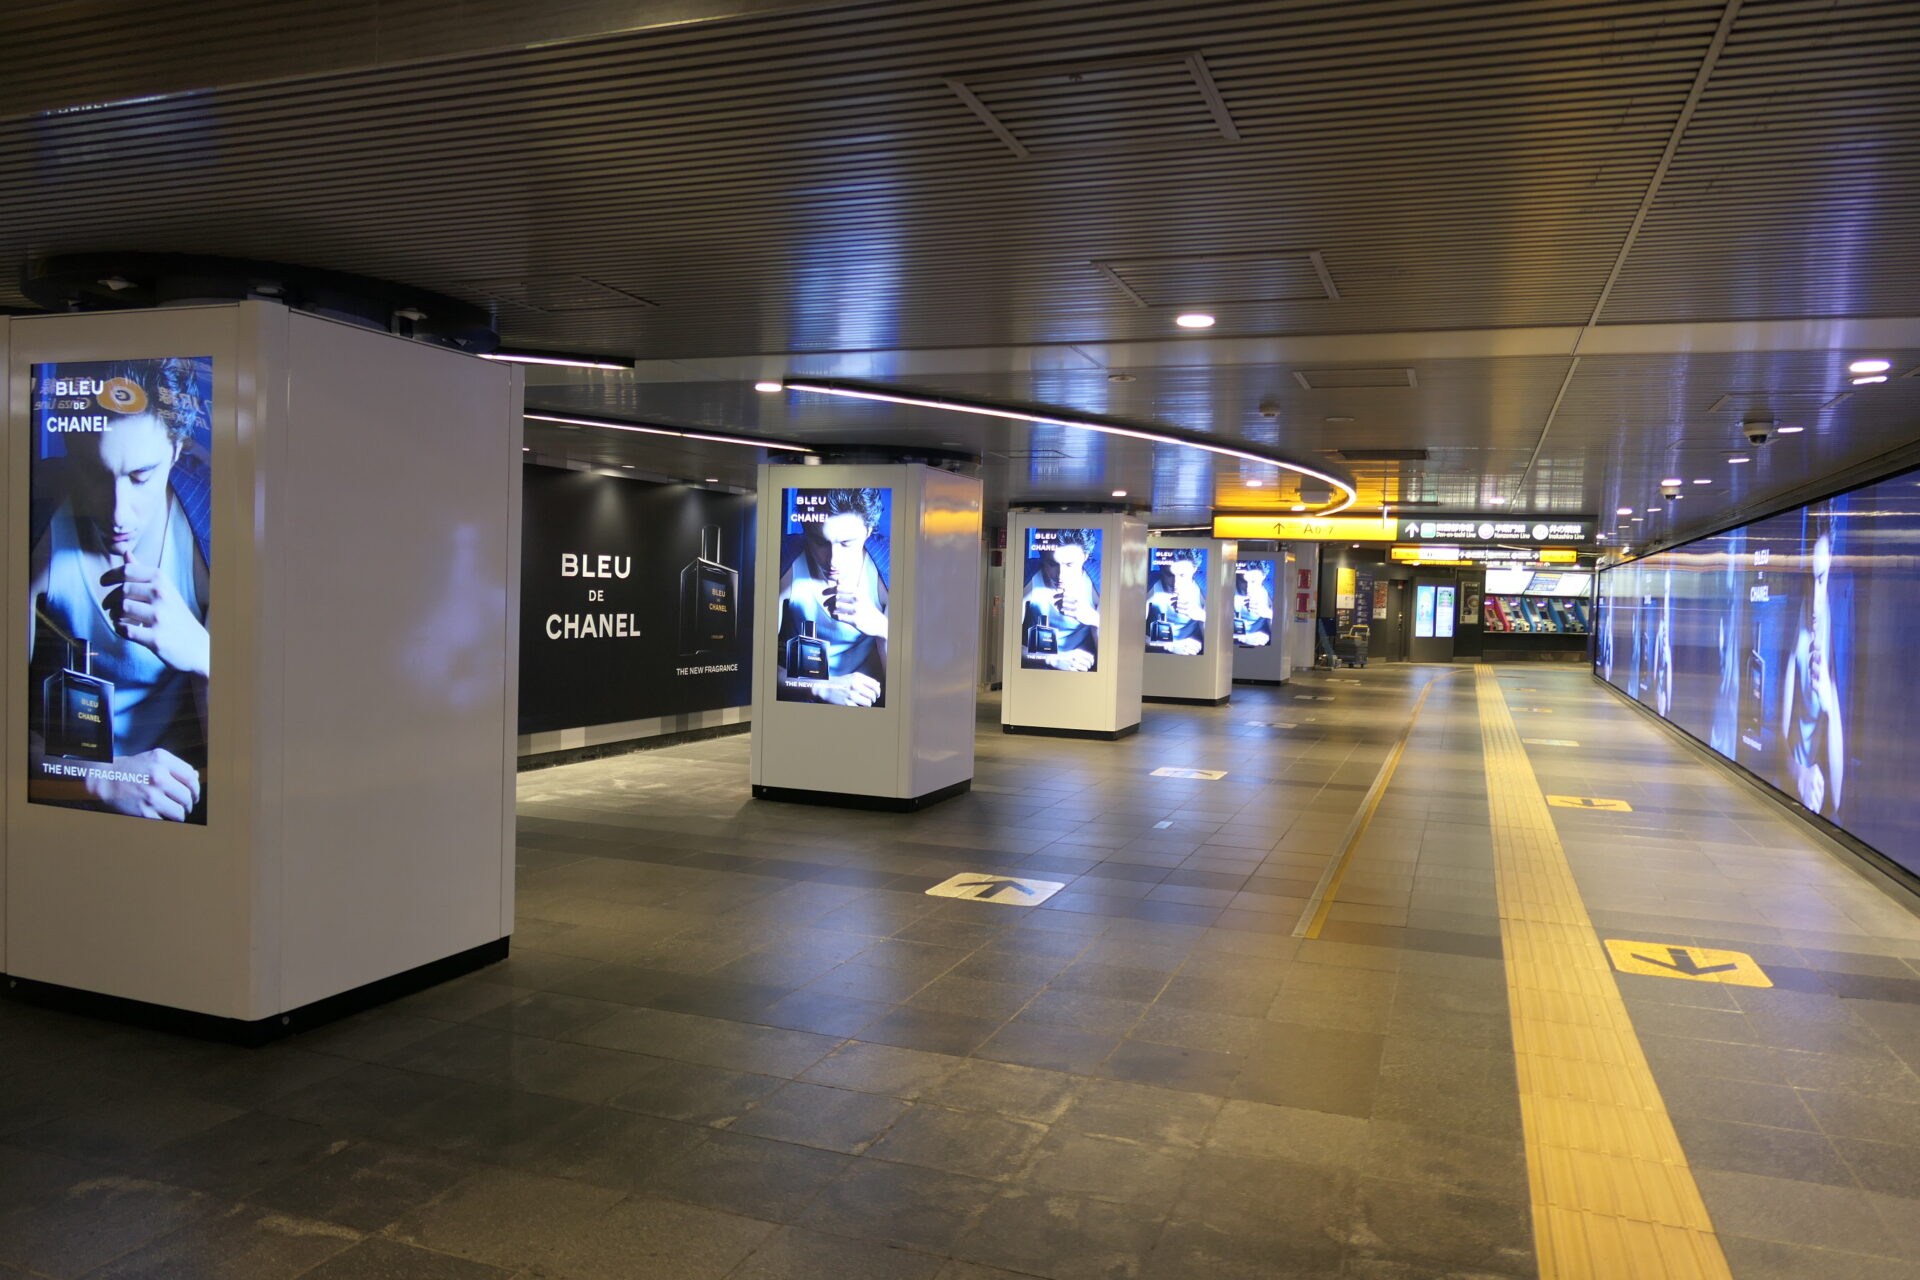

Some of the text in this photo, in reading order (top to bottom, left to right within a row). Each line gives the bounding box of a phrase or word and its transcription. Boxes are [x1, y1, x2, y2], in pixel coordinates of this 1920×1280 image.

[56, 380, 104, 396] BLEU
[73, 401, 85, 410] DE
[46, 415, 112, 433] CHANEL
[796, 496, 827, 505] BLEU
[1754, 548, 1770, 566] BLEU
[561, 553, 631, 579] BLEU
[588, 590, 604, 602] DE
[711, 588, 726, 598] BLEU
[709, 603, 728, 613] CHANEL
[545, 613, 641, 640] CHANEL
[676, 663, 739, 676] THE NEW FRAGRANCE
[42, 763, 150, 785] THE NEW FRAGRANCE
